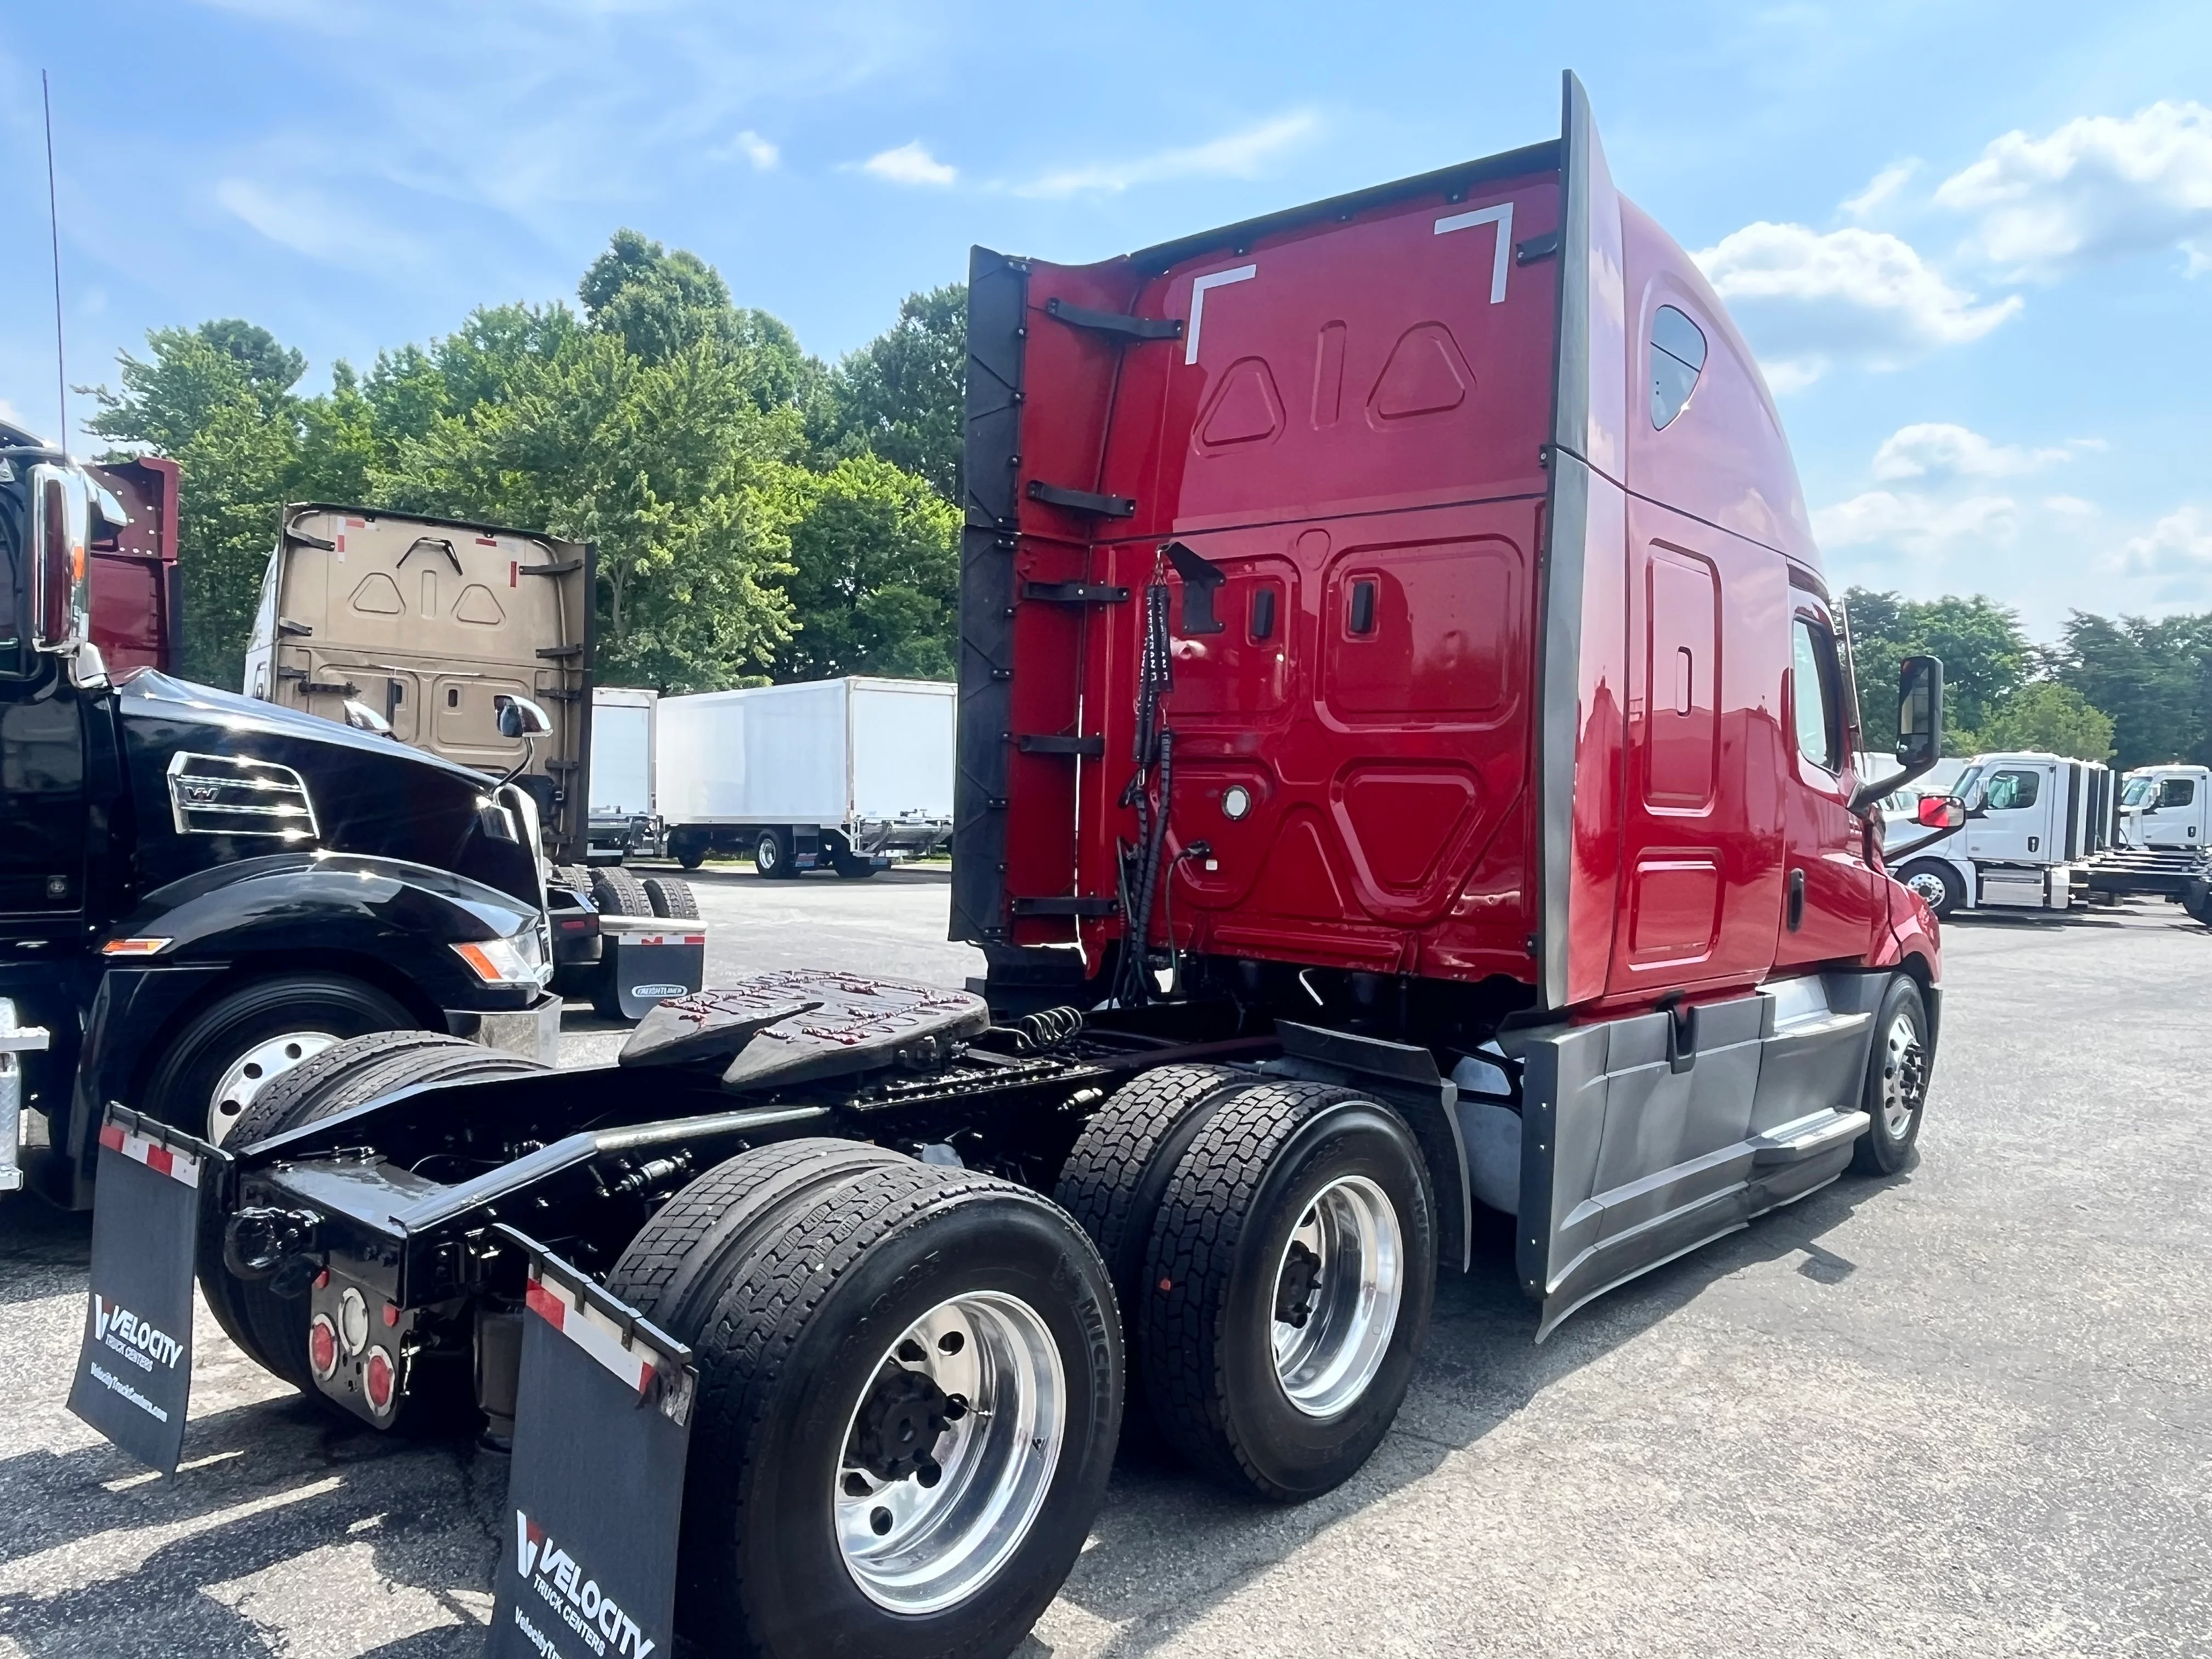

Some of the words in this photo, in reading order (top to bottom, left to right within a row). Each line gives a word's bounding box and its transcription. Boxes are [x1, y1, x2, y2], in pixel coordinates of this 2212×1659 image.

[110, 1305, 184, 1369] VELOCITY
[533, 1573, 564, 1614] TRUCK
[562, 1605, 606, 1657] CENTERS
[539, 1537, 656, 1659] VELOCITY
